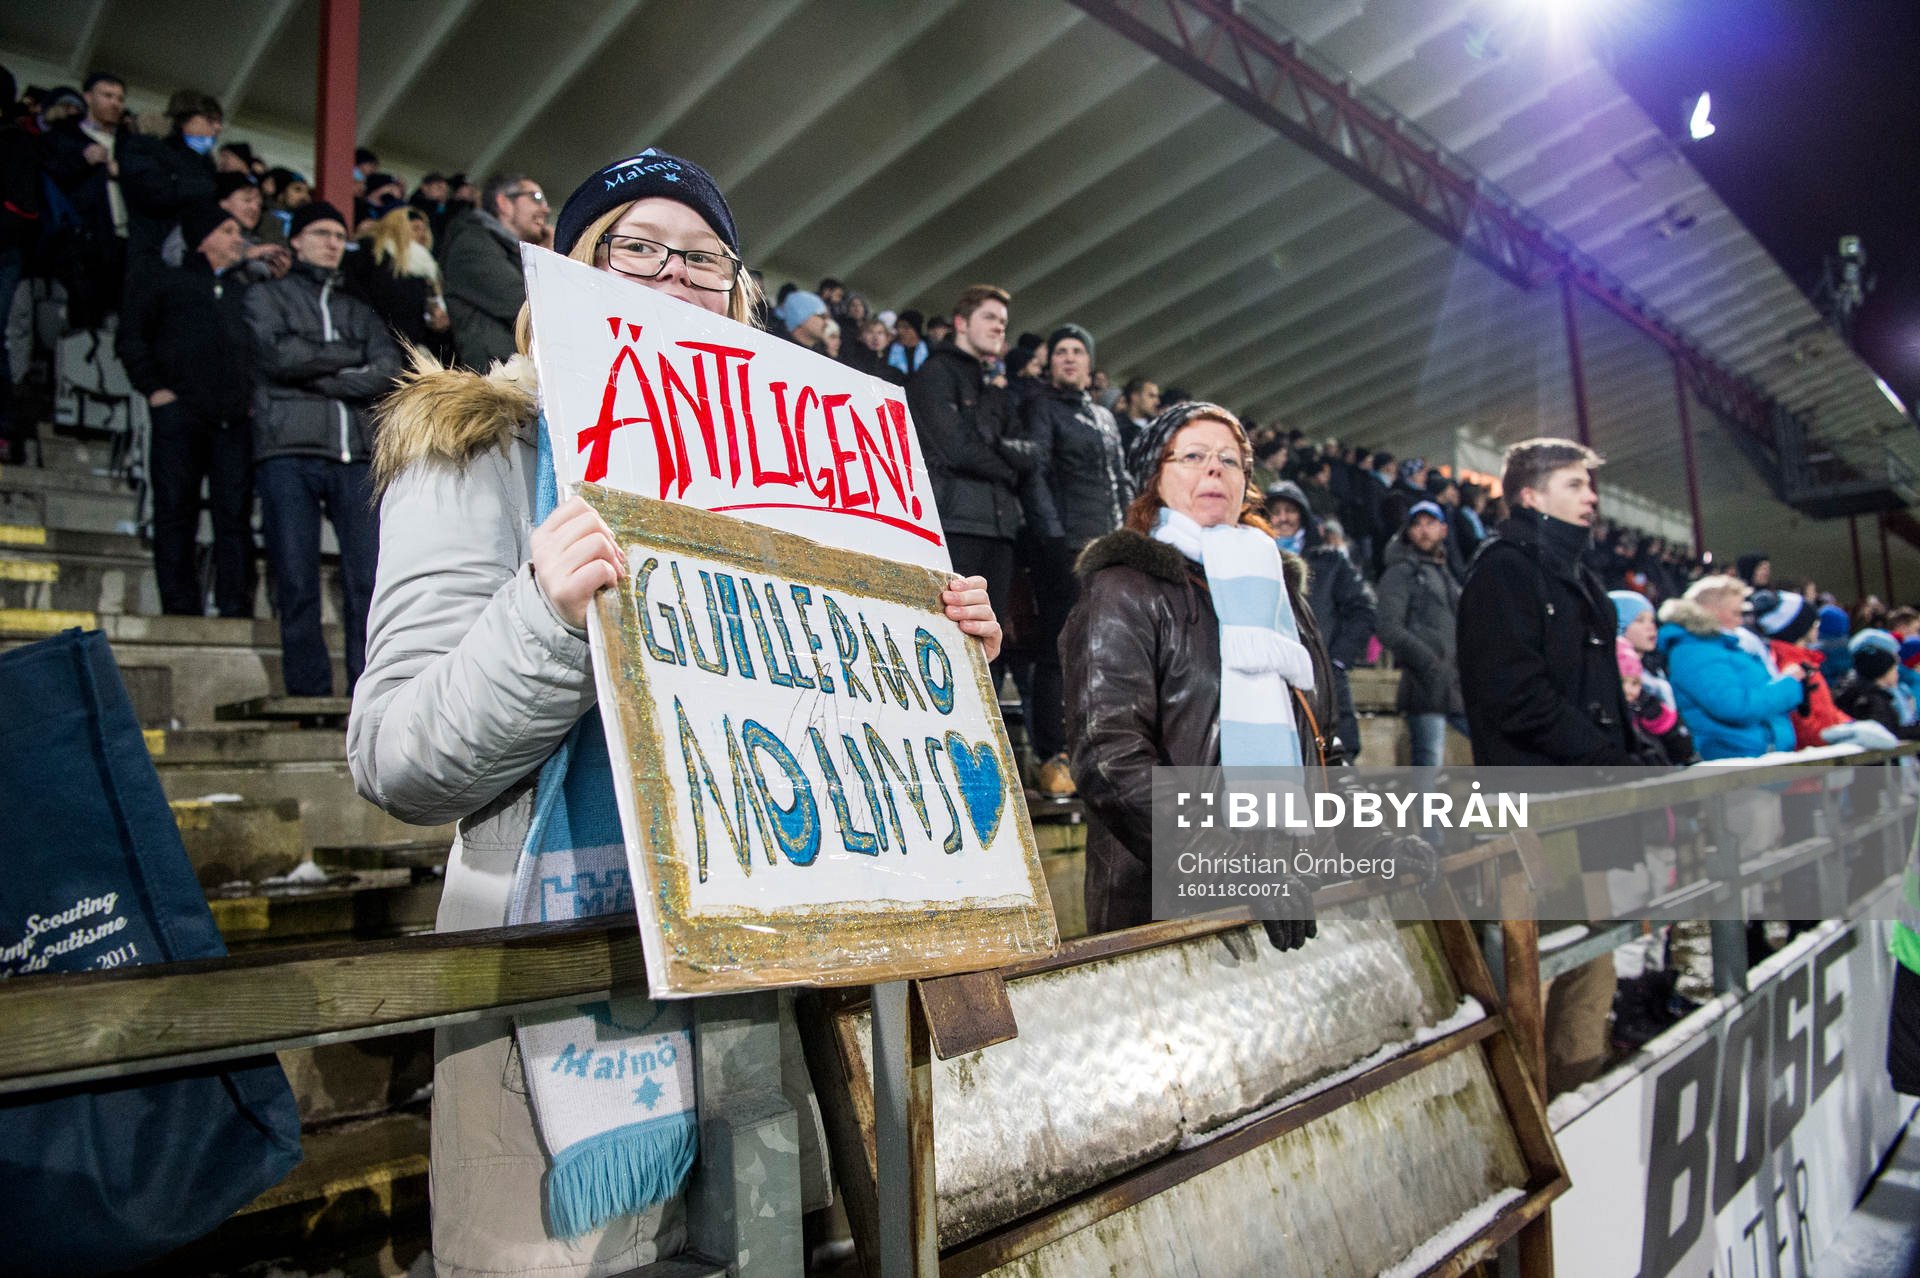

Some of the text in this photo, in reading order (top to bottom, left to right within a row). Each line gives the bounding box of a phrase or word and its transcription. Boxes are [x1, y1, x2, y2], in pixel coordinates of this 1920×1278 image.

[604, 159, 682, 191] Malmö
[577, 316, 923, 520] ÄNTLIGEN!
[635, 557, 954, 715] GUILLERMO
[673, 694, 963, 883] MOLINS
[25, 891, 119, 938] Scouting
[96, 942, 139, 970] 2011
[550, 1035, 678, 1080] Malmö
[1634, 926, 1858, 1278] BOSE
